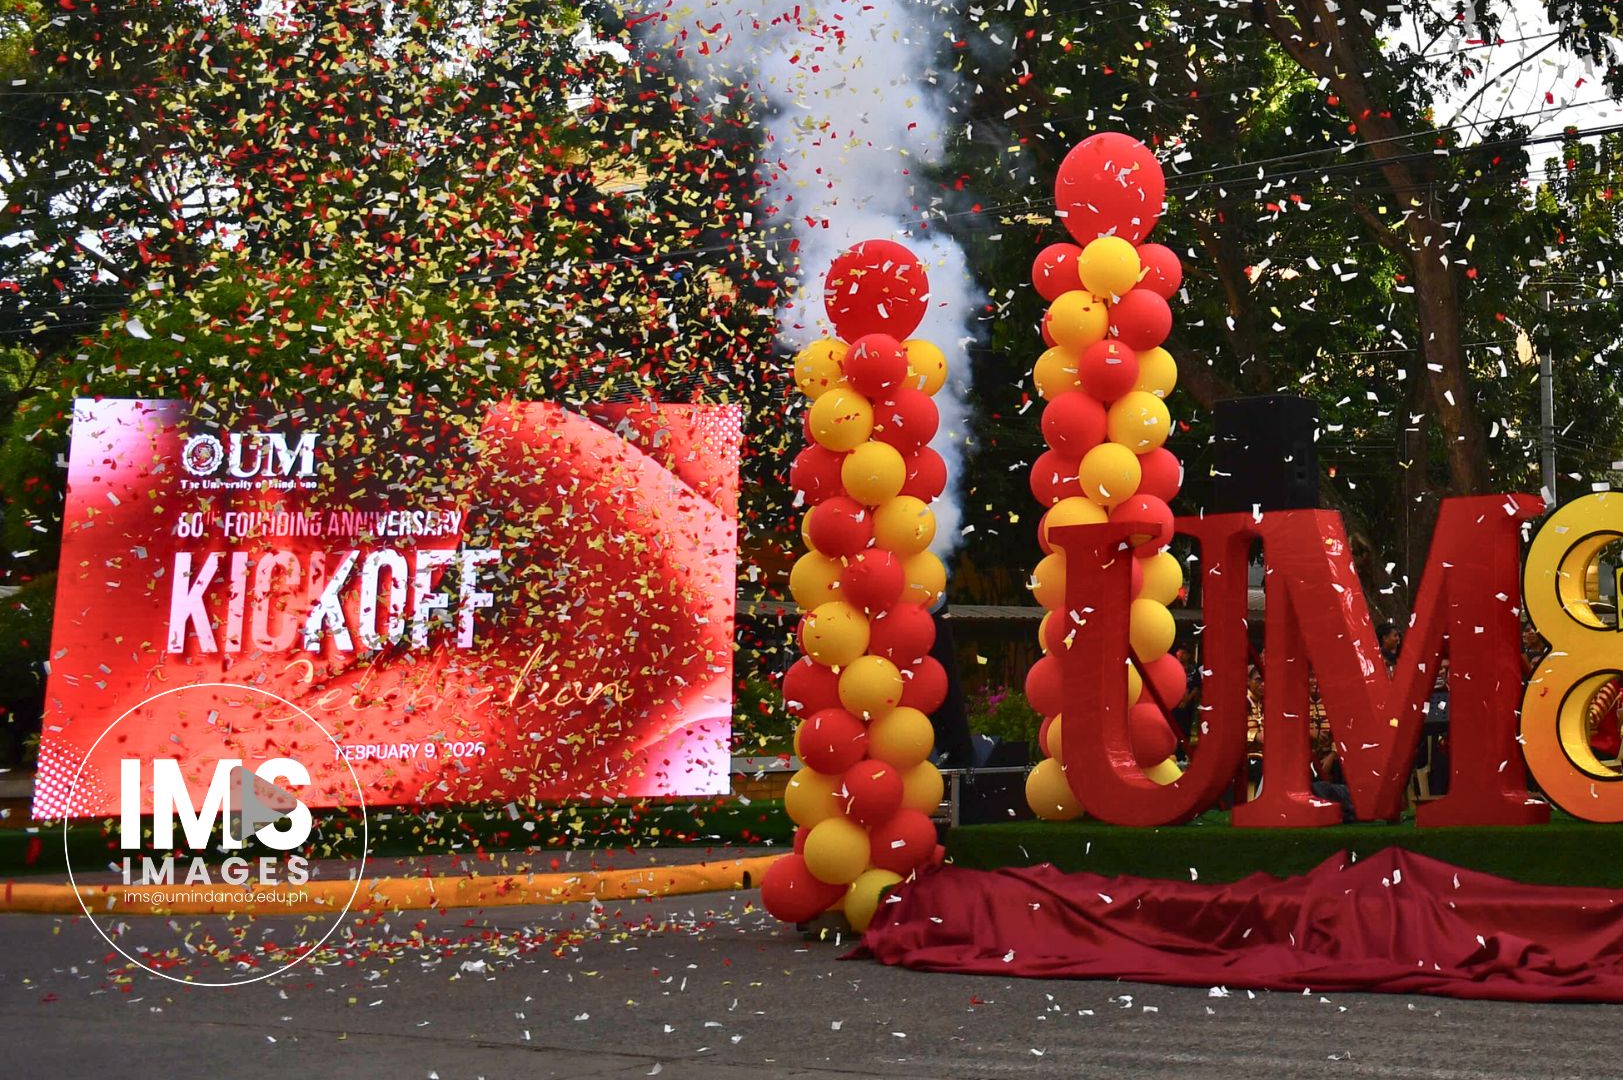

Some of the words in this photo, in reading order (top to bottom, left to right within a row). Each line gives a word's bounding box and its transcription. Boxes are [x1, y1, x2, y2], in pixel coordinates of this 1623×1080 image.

[228, 432, 321, 478] UM
[224, 511, 322, 537] FOUNDING
[326, 509, 463, 537] ANNIVERSARY
[166, 549, 503, 654] KICKOFF
[1050, 494, 1551, 829] UM
[335, 744, 419, 760] FEBRUARY
[443, 742, 485, 757] 2026
